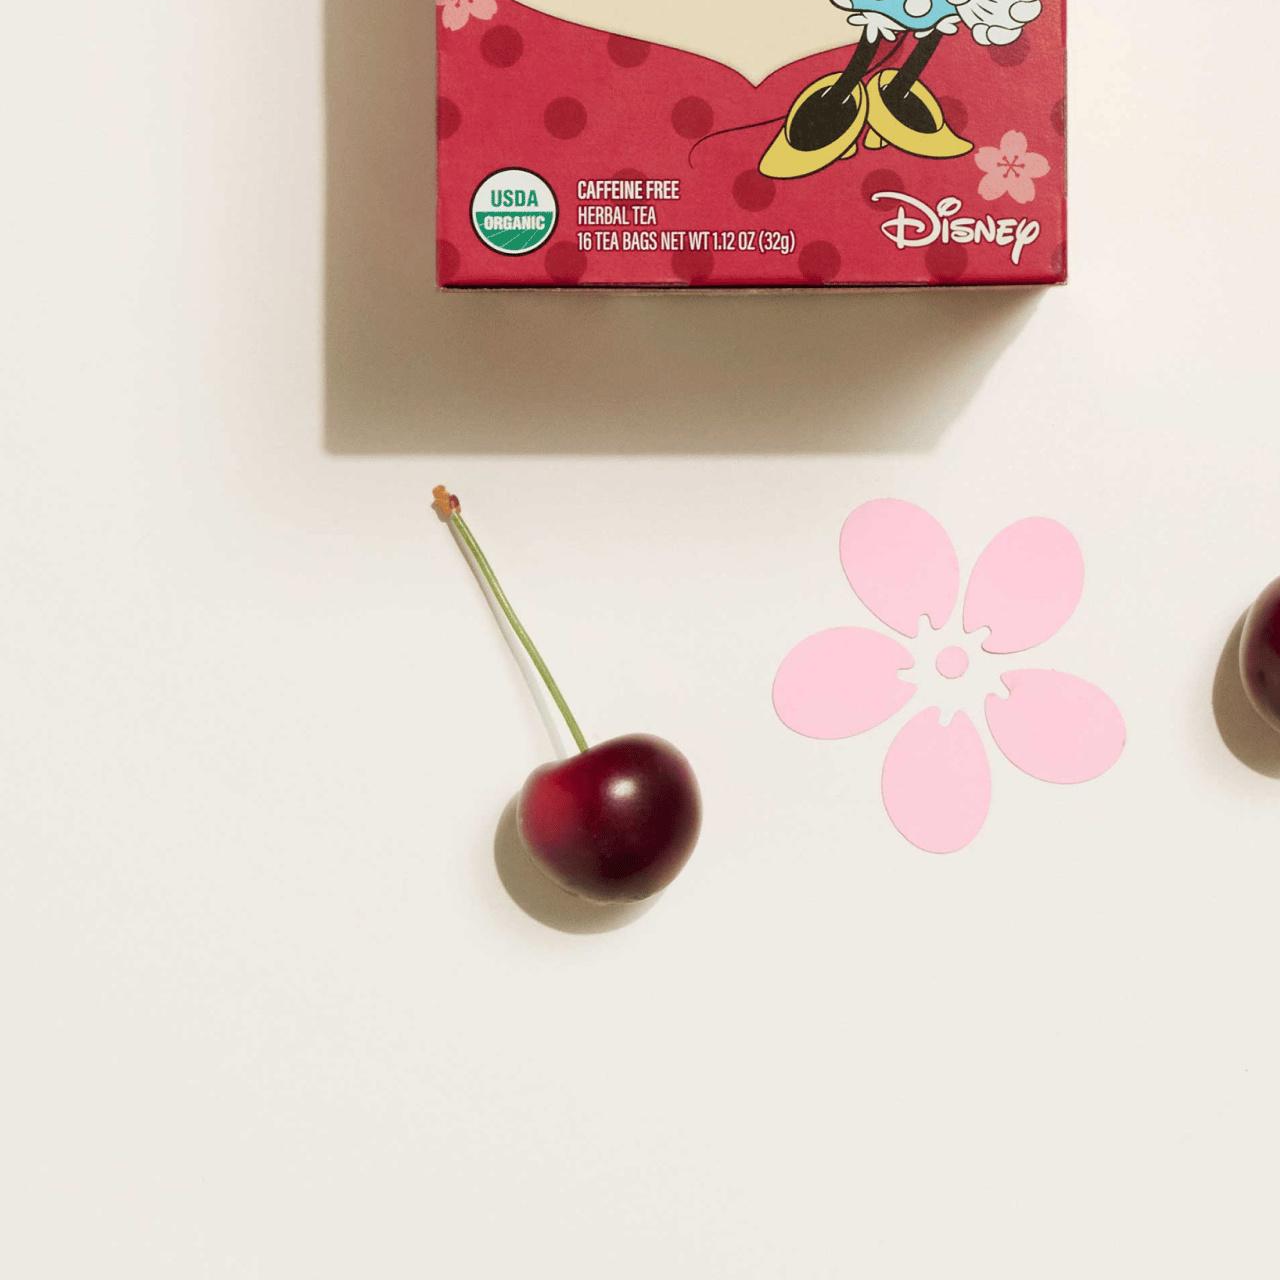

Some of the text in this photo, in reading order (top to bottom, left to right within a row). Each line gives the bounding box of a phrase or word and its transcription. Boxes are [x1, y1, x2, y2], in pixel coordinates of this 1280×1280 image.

[490, 189, 539, 207] USDA
[577, 179, 680, 200] CAFFEINE FREE
[482, 215, 546, 231] ORGANIC
[577, 205, 657, 226] HERBAL TEA
[577, 229, 796, 255] 16 TEA BAGS NET WT 1.12 OZ (32g)
